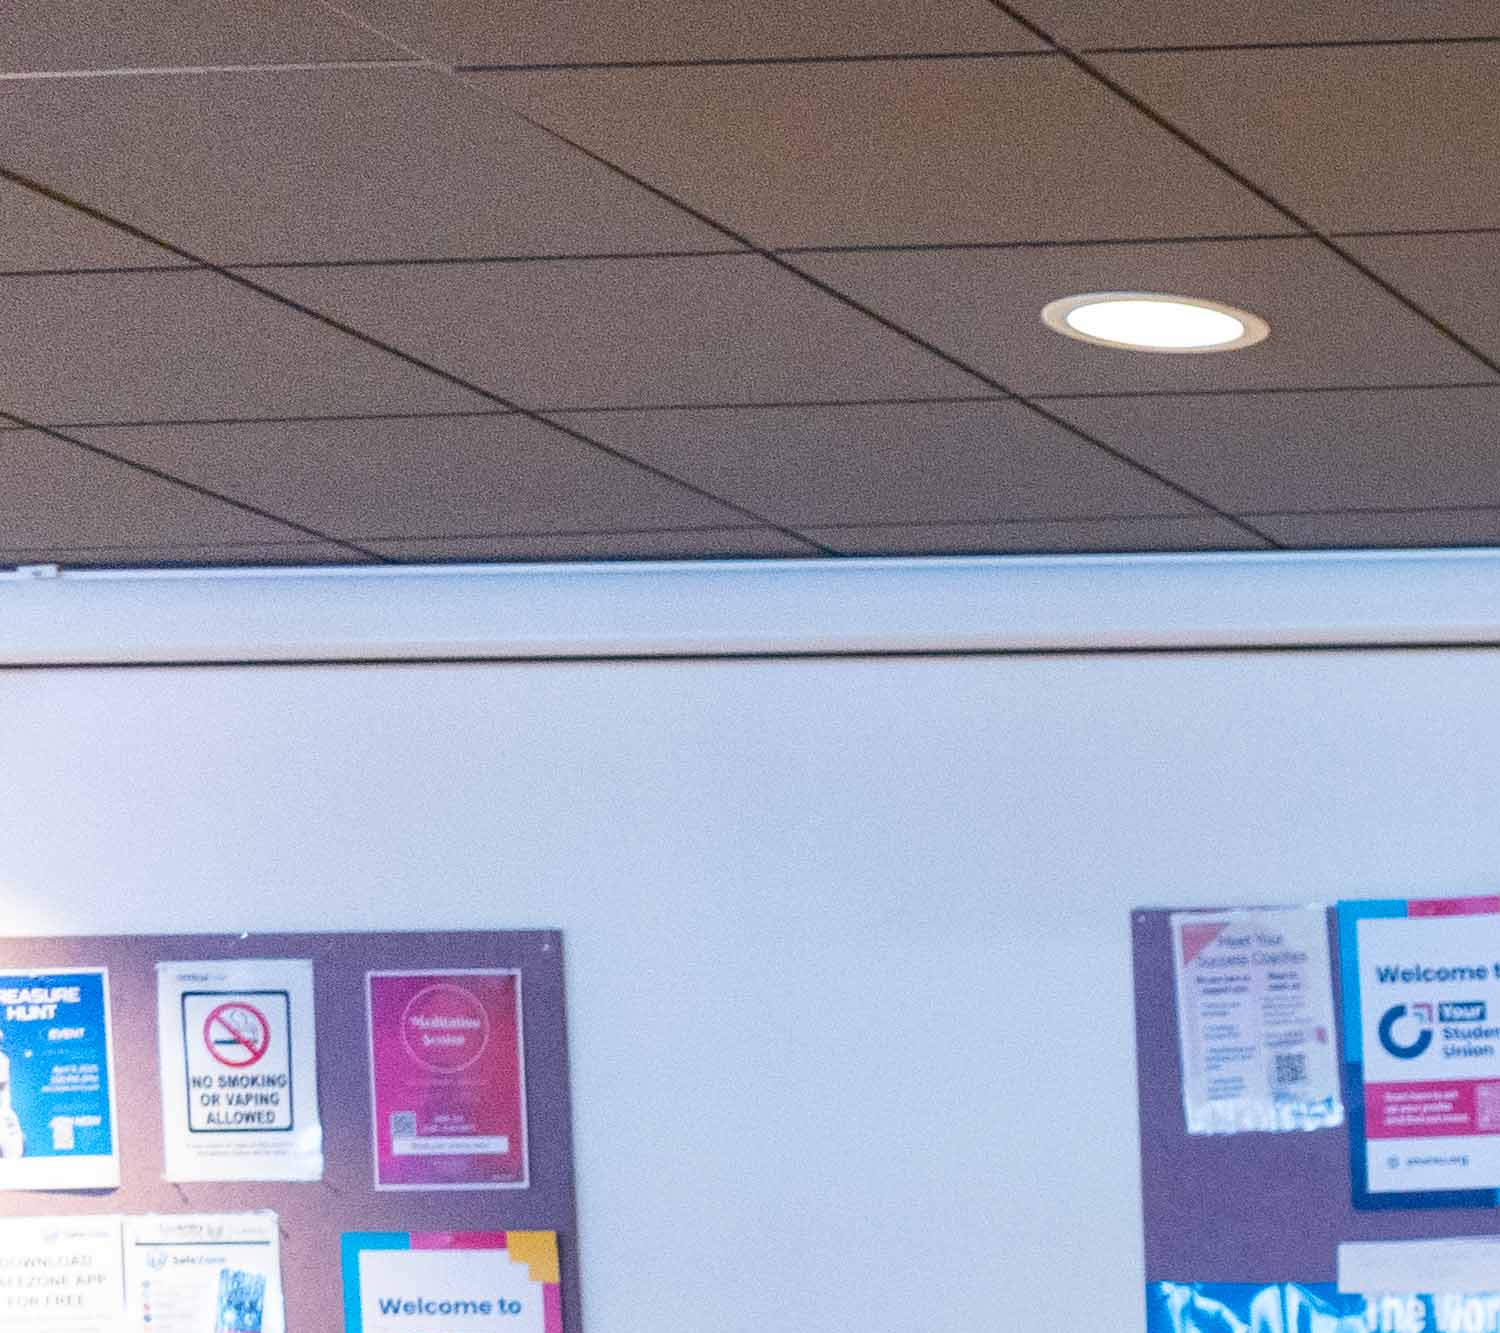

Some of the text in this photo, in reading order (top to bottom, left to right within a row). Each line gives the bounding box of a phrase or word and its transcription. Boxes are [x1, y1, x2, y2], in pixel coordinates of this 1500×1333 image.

[1376, 962, 1488, 984] Welcome
[1442, 1042, 1495, 1058] Union
[192, 1074, 287, 1089] NO SMOKING
[200, 1093, 280, 1107] OR VAPING
[206, 1111, 276, 1125] ALLOWED
[379, 1297, 522, 1316] Welcome to
